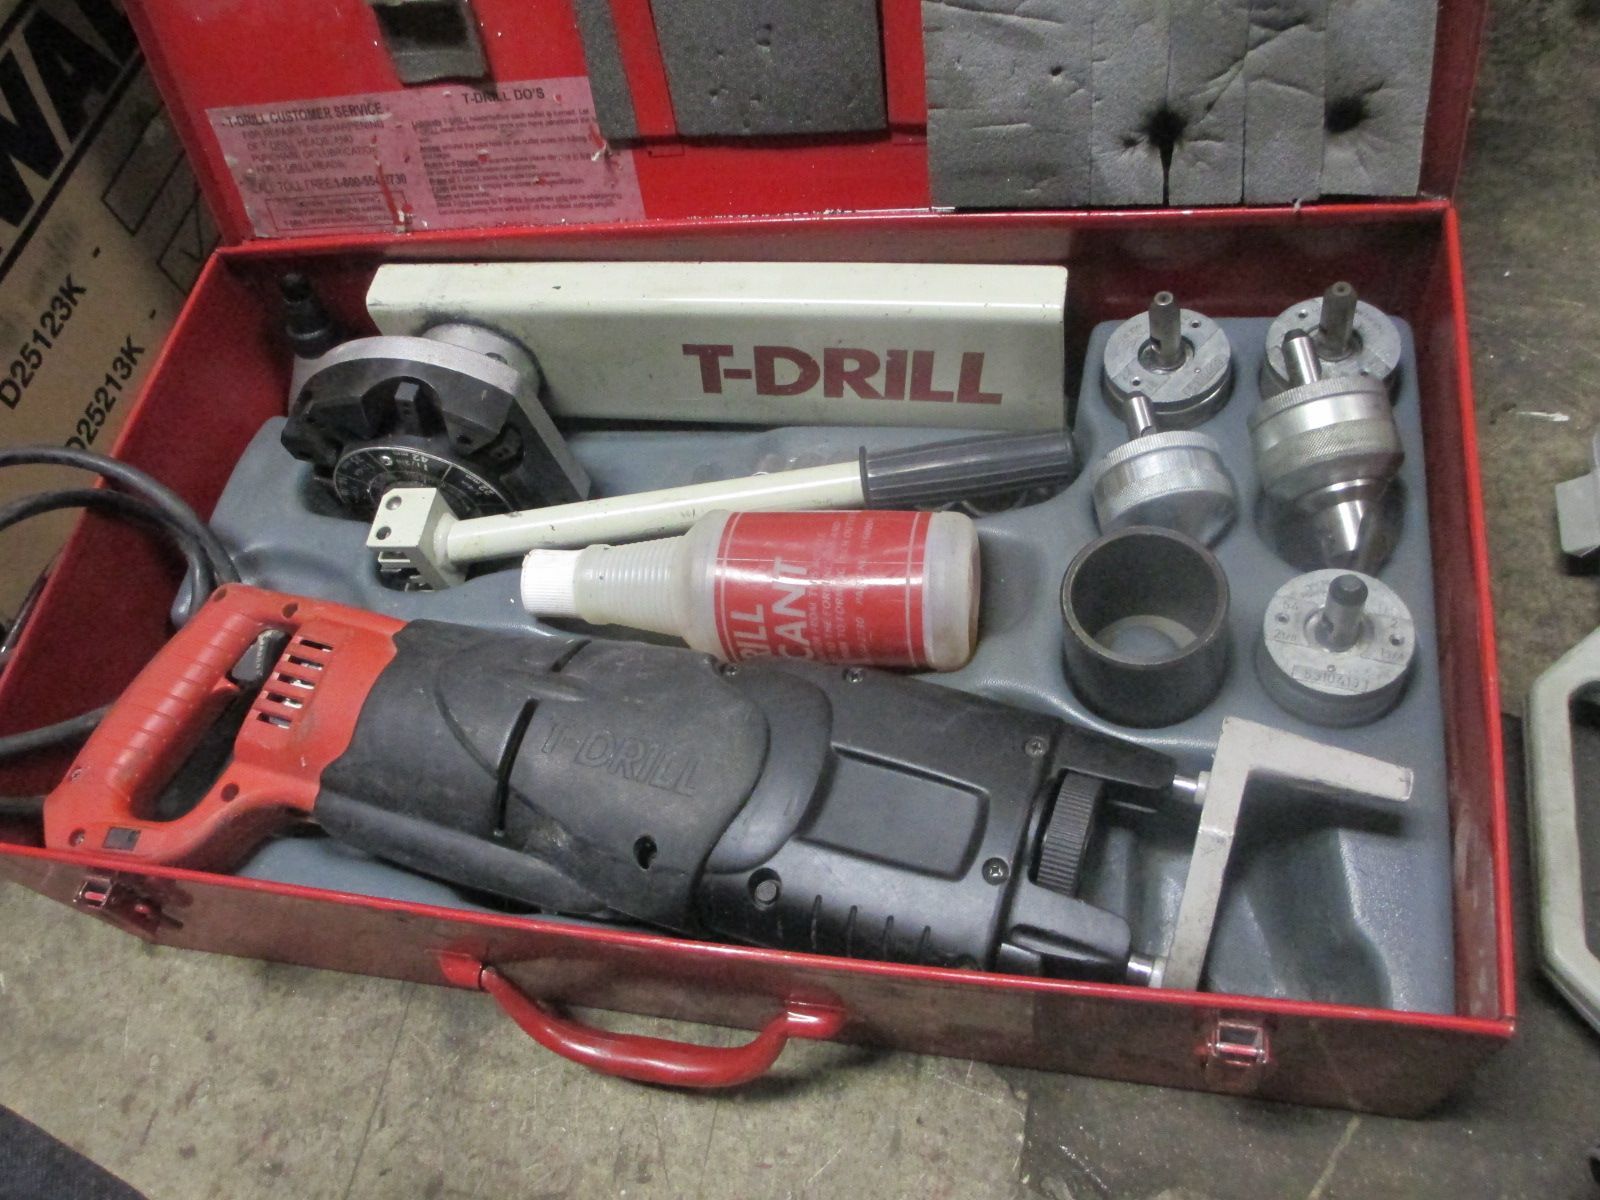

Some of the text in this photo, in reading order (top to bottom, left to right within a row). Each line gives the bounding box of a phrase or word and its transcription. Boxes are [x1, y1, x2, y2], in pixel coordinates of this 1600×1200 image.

[269, 106, 331, 123] CUSTOMER
[333, 102, 384, 118] SERVICE
[513, 87, 545, 101] DO'S
[0, 272, 87, 411] D25123K
[682, 343, 1003, 405] T-DRILL
[541, 716, 700, 798] T-DRILL
